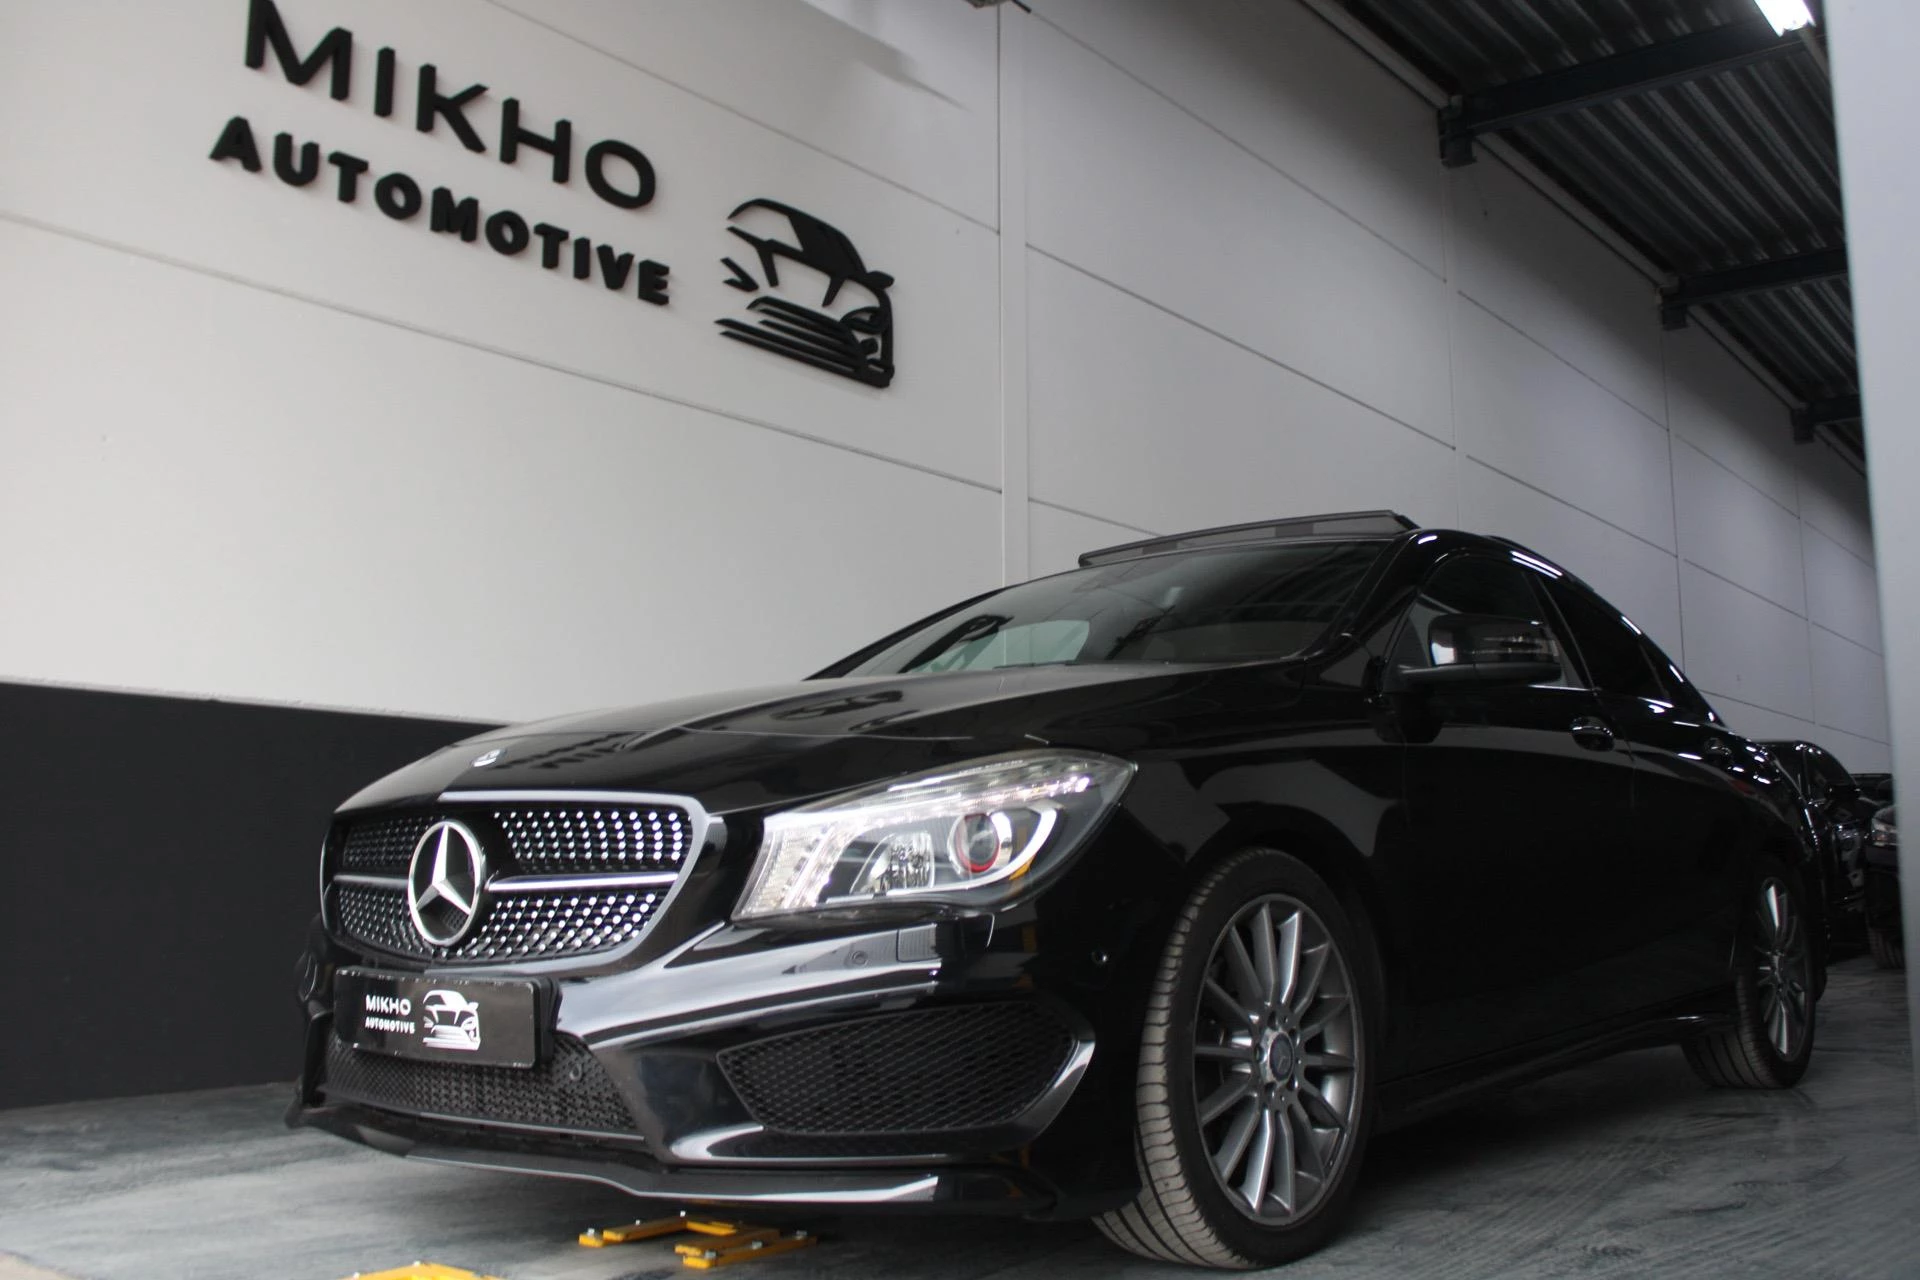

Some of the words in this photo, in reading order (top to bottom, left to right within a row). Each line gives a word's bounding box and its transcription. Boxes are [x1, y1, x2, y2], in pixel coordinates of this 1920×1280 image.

[244, 0, 656, 210] MIKHO
[209, 116, 670, 306] AUTOMOTIVE
[365, 995, 411, 1016] MIKHO
[365, 1016, 415, 1034] AUTOMOTIVE
